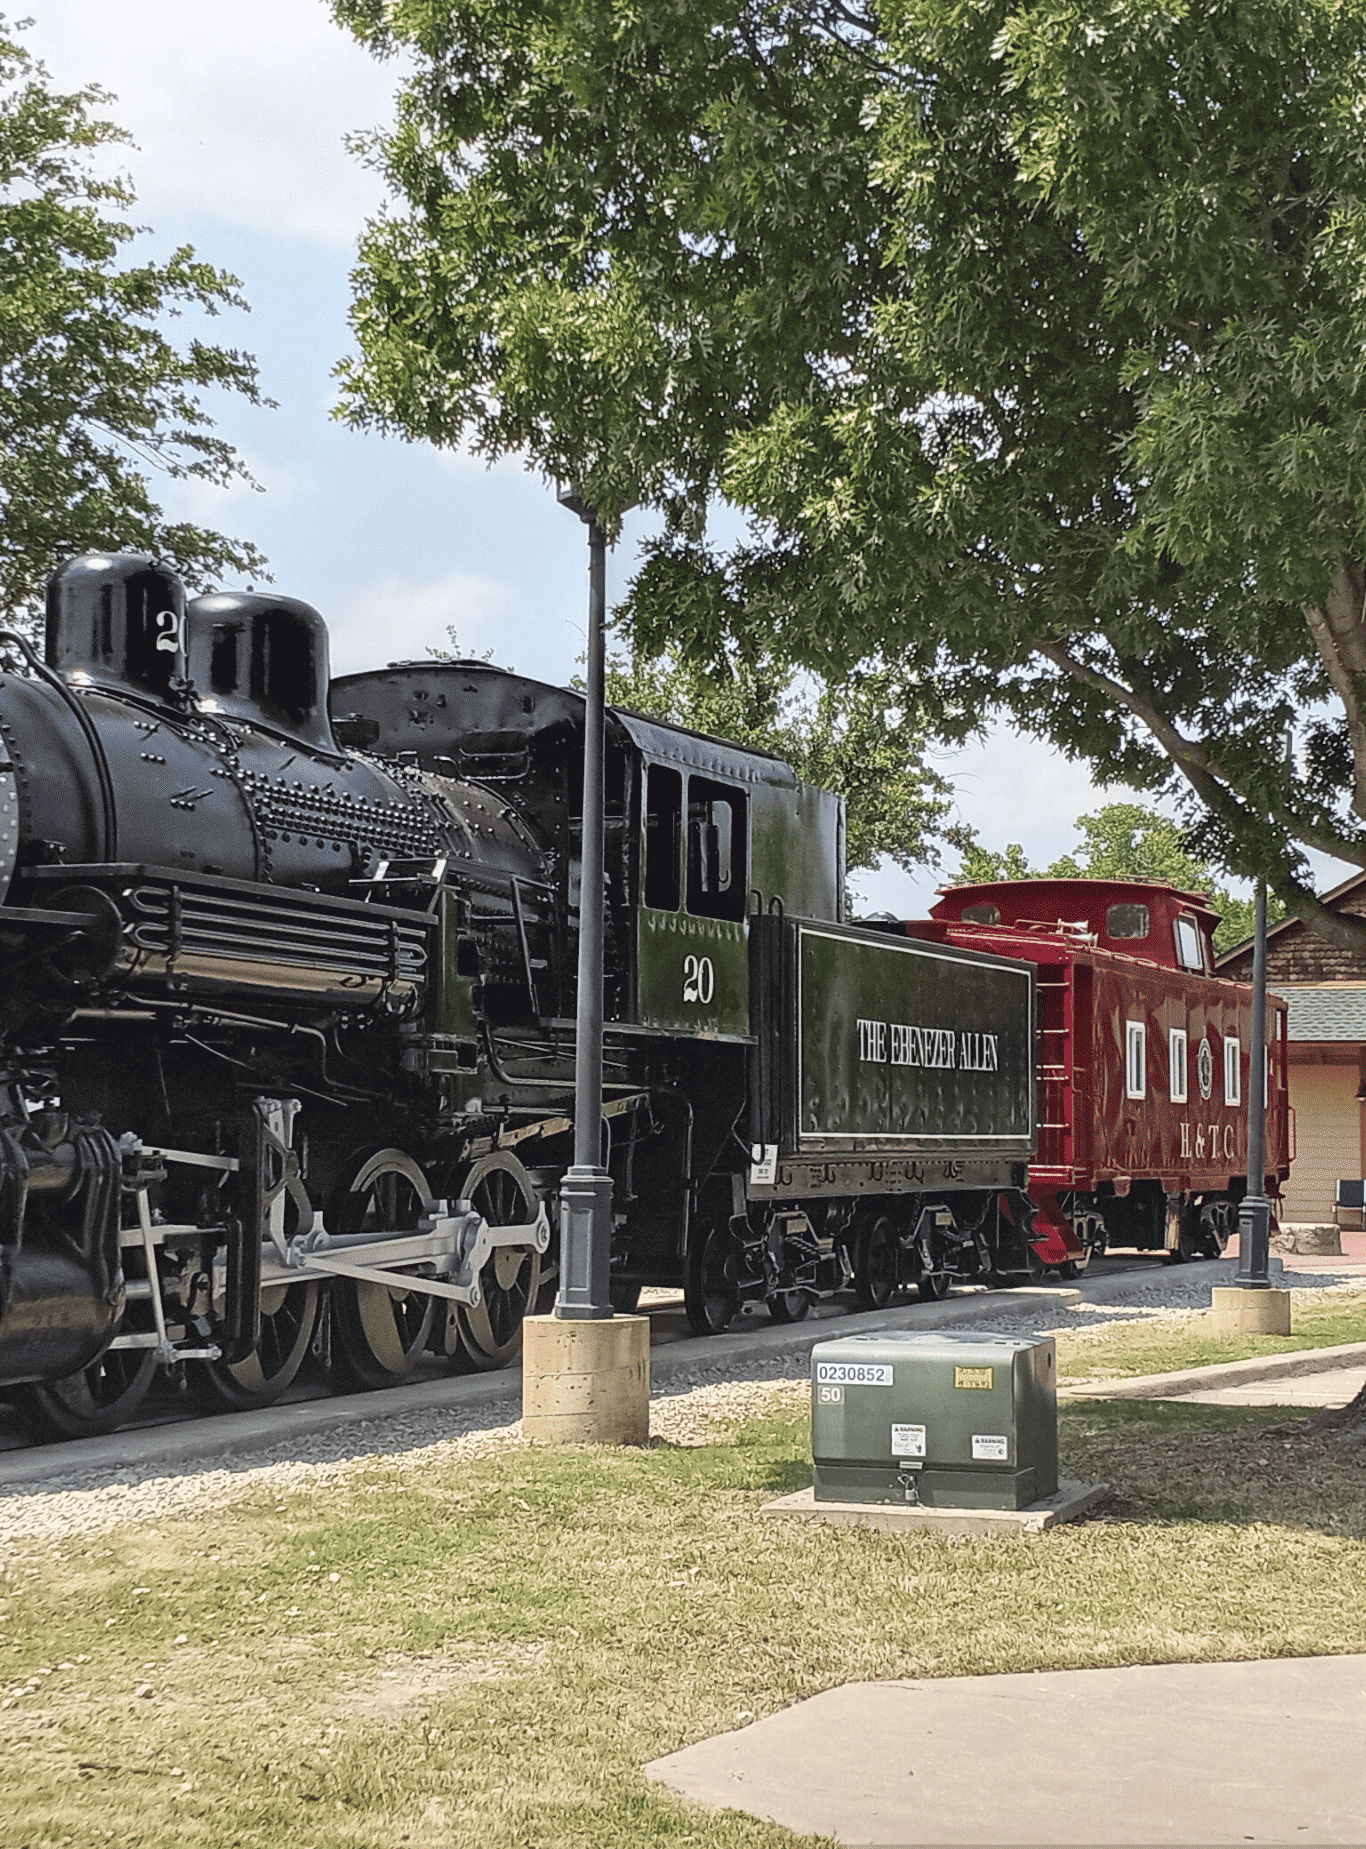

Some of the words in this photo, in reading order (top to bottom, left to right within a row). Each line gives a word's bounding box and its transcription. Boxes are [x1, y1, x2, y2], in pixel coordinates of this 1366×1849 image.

[683, 954, 714, 1004] 20
[856, 1018, 887, 1063] THE
[889, 1023, 956, 1070] EBENEZER
[958, 1031, 999, 1072] ALLEN
[819, 1366, 886, 1382] 0230852
[820, 1386, 841, 1402] 50
